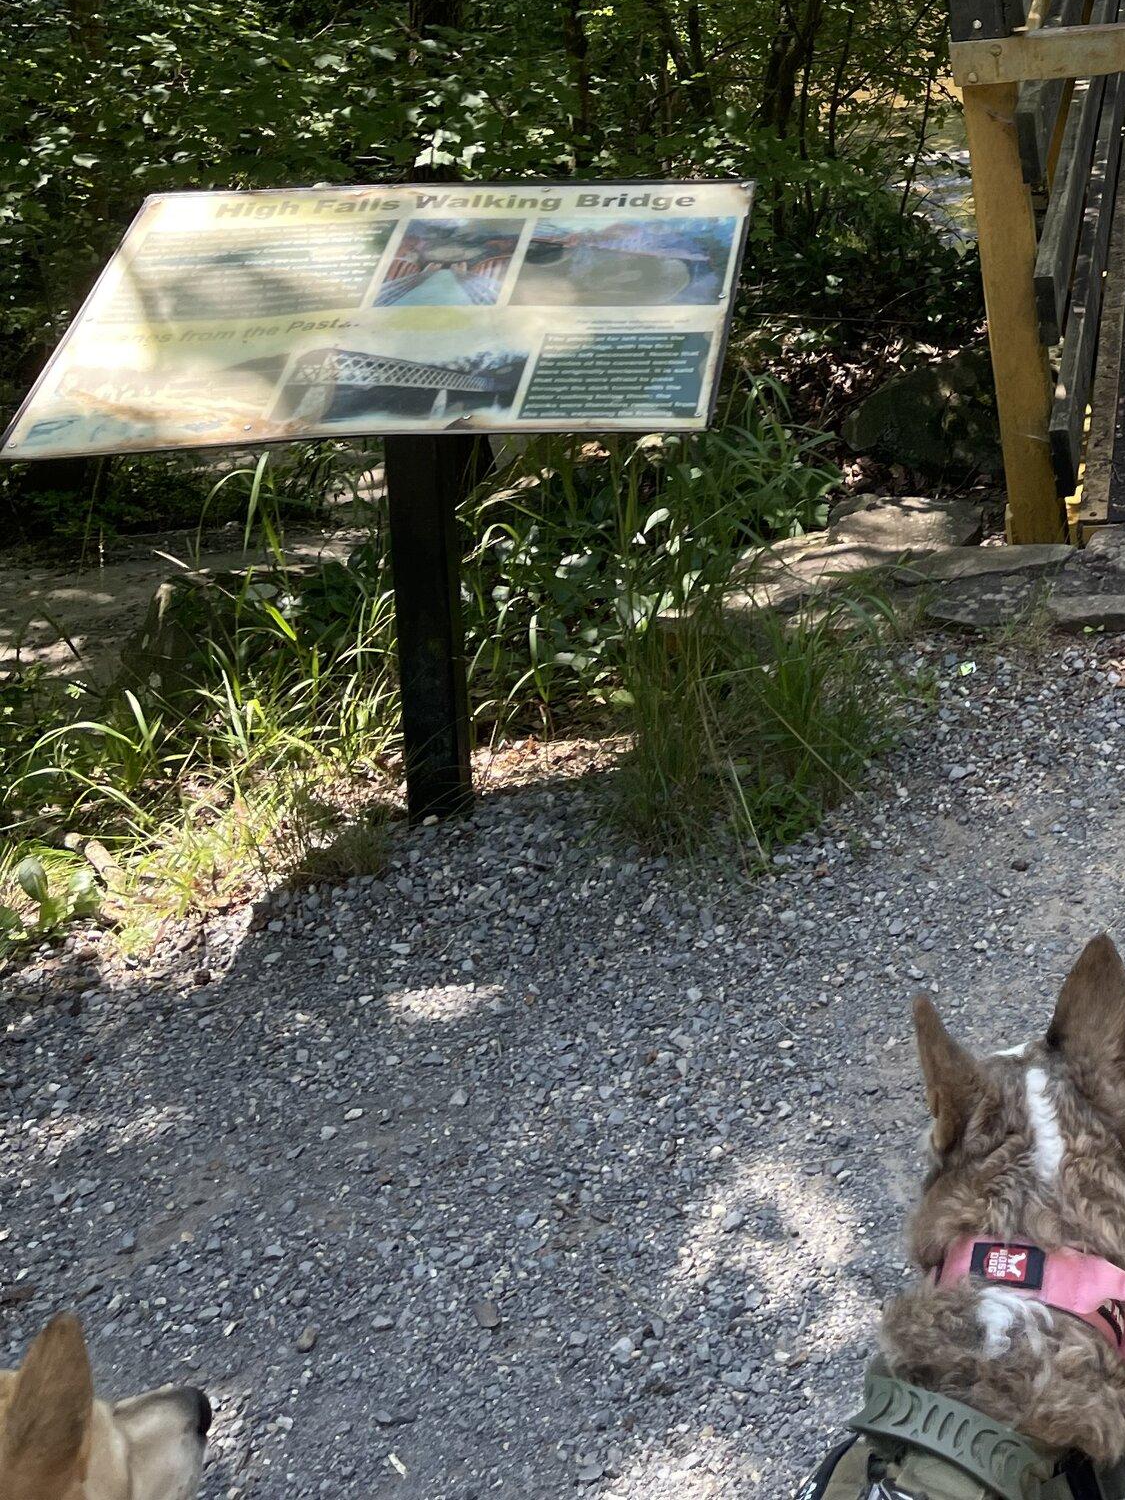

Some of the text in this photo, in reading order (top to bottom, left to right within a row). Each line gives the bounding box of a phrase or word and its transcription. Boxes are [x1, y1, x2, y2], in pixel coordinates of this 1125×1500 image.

[215, 193, 697, 220] High Falls Walking Bridge
[180, 329, 236, 342] from
[242, 325, 280, 339] the
